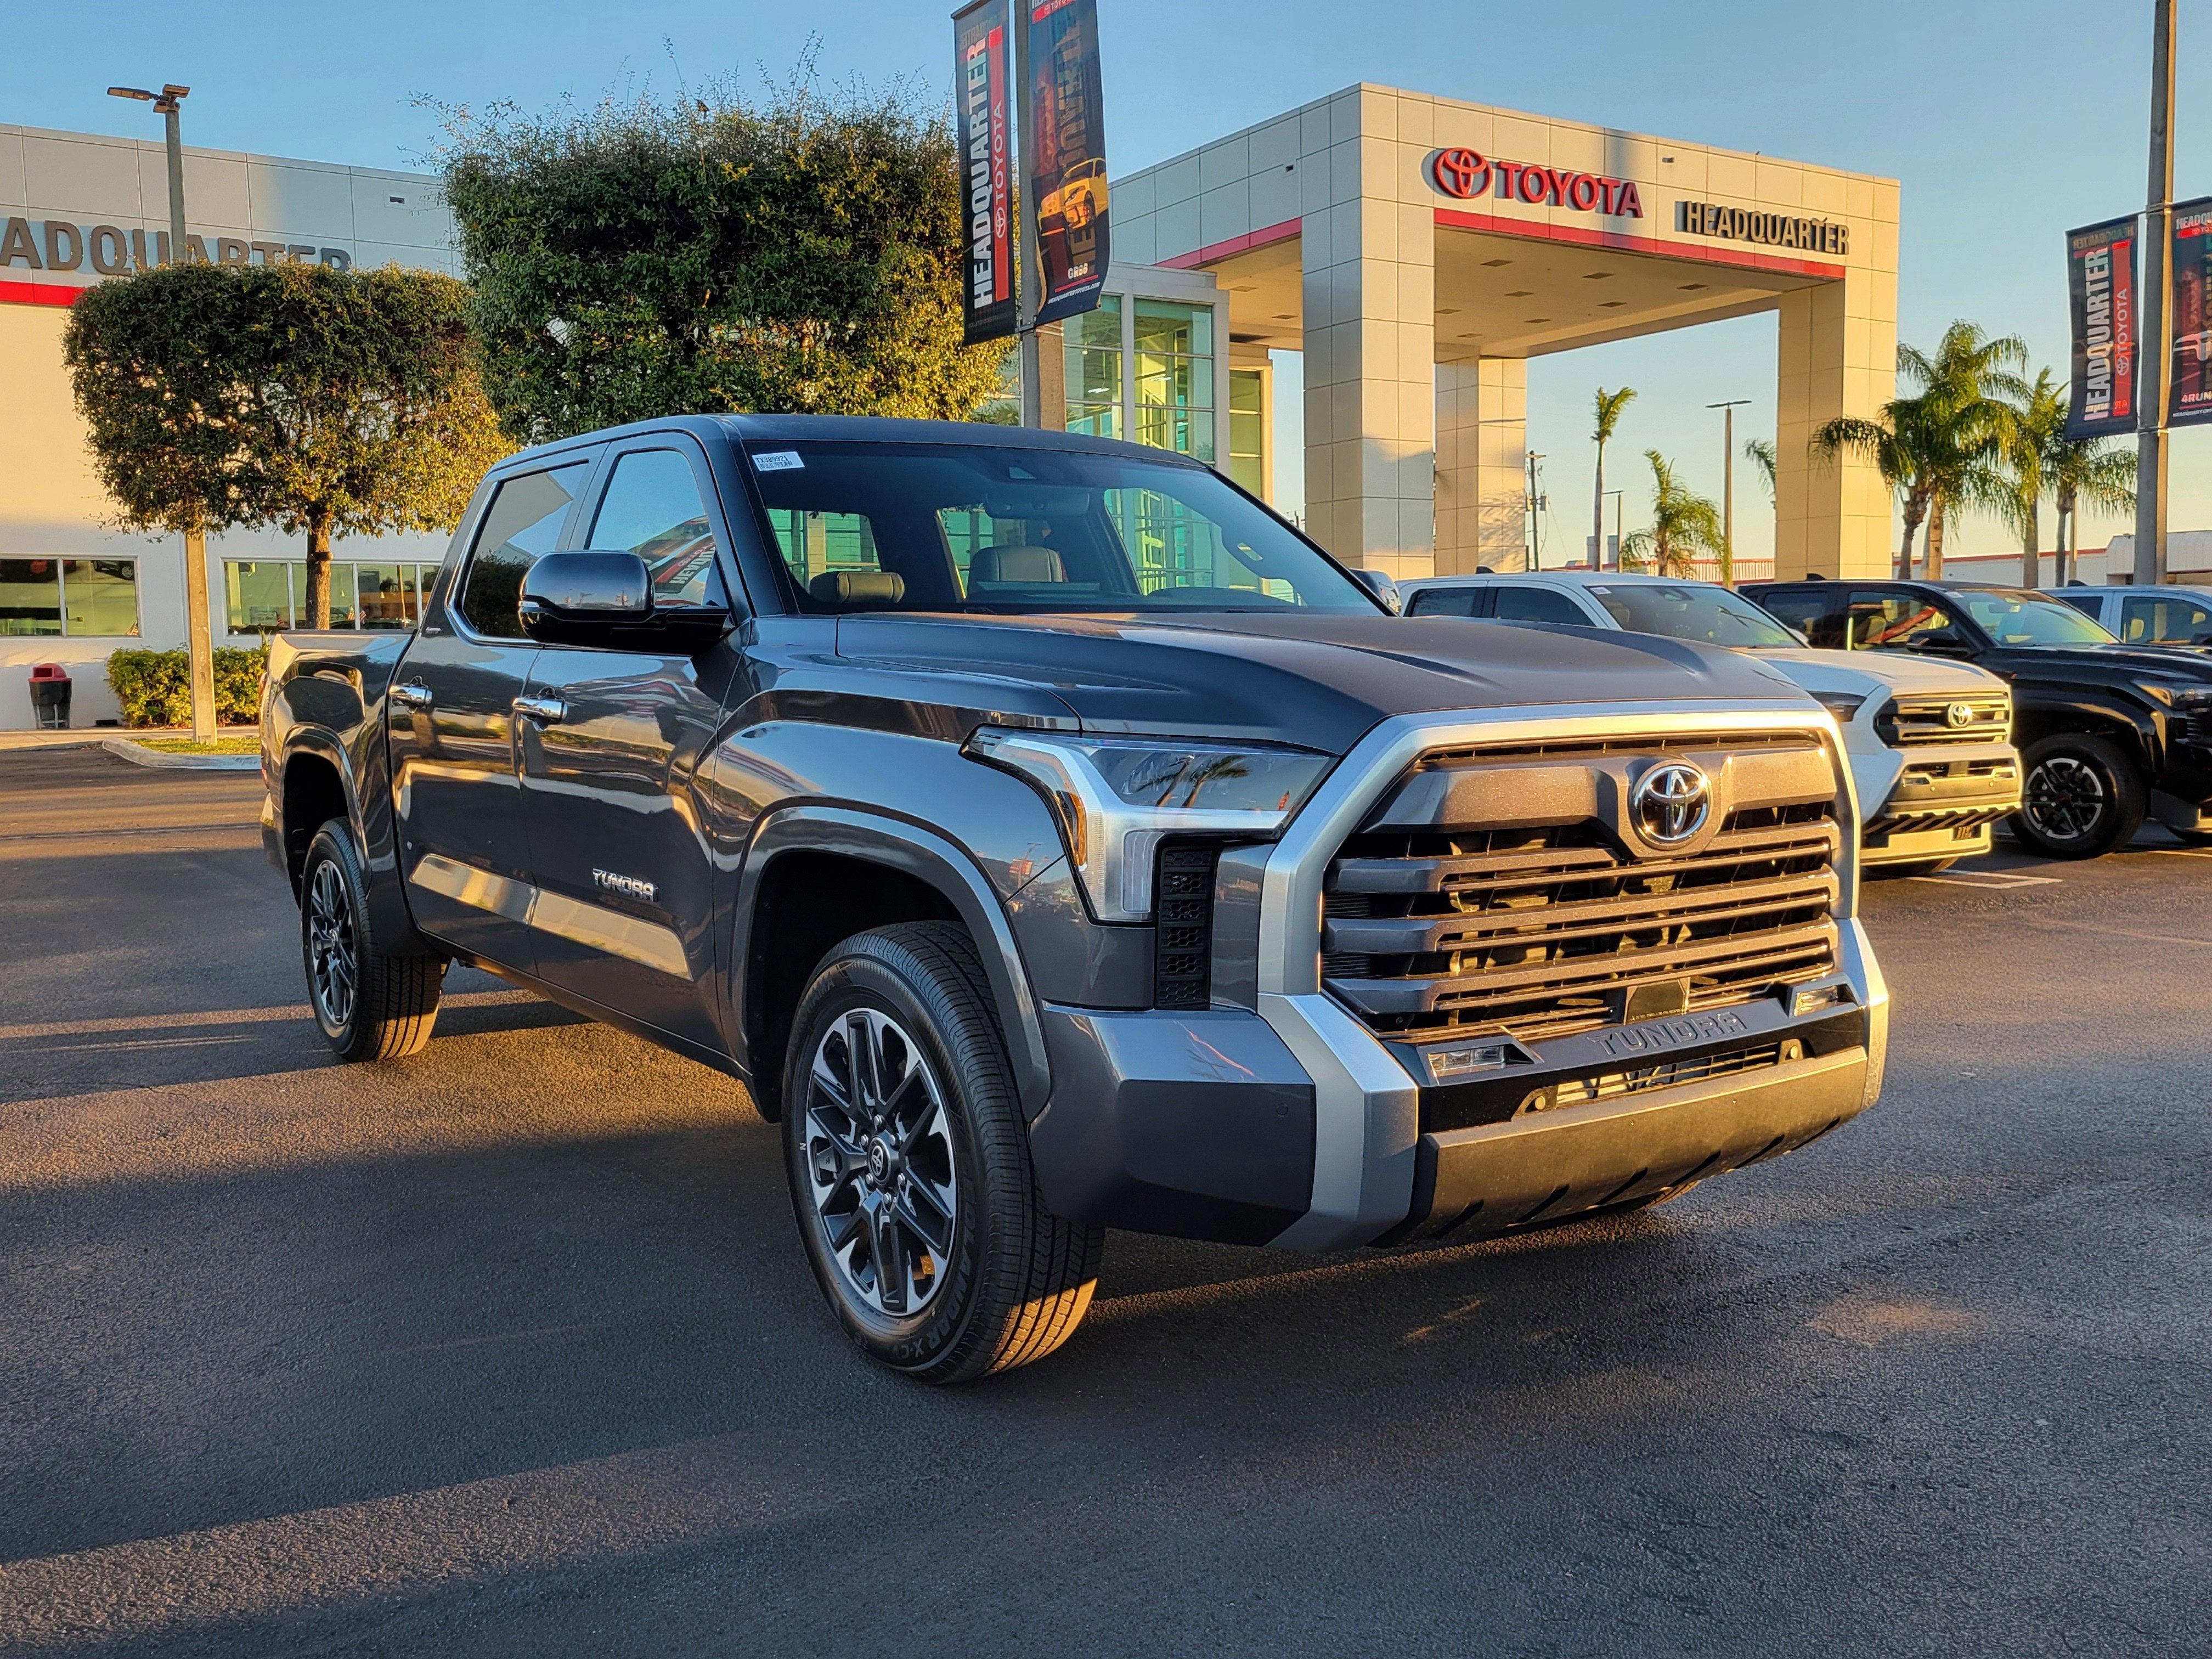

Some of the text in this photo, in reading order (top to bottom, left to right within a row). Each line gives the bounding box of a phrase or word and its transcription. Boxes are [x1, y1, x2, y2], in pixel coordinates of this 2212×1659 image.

[967, 36, 992, 309] HEADQUARTER
[994, 101, 1003, 205] TOYOTA
[1499, 161, 1643, 218] TOYOTA
[1686, 201, 1849, 255] HEADQUARTER
[1068, 263, 1088, 279] GR86
[2084, 247, 2113, 421] HEADQUARTER
[2117, 288, 2128, 358] TOYOTA
[592, 868, 658, 902] TUNDRA
[1587, 1012, 1748, 1056] TUNDRA
